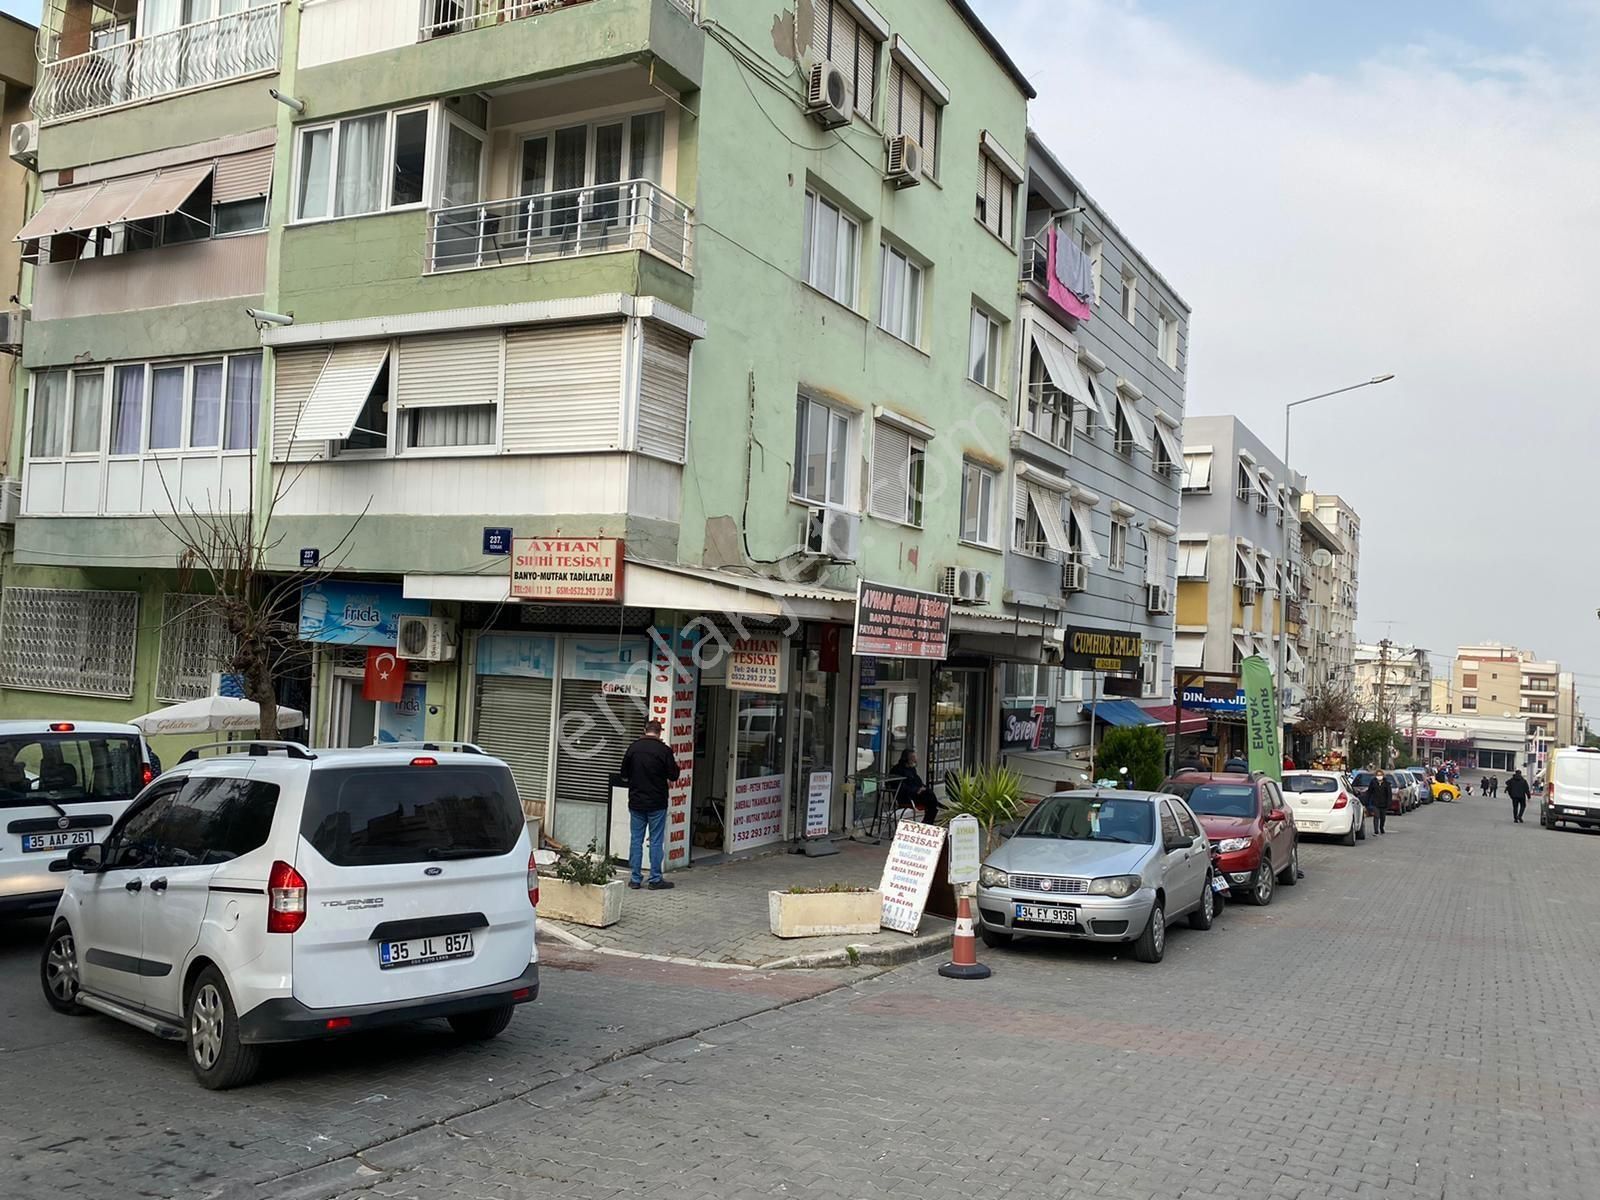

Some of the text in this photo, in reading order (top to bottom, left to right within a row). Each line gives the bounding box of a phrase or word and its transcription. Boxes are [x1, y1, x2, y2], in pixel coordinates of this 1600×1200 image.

[528, 541, 600, 553] AYHAN
[556, 554, 611, 568] TESİSAT
[514, 571, 613, 582] BANYO-MUTFAK TADİLATLARI
[862, 589, 894, 611] AYHAN
[919, 597, 949, 619] TESİSAT
[869, 613, 891, 624] BANYO
[892, 615, 916, 627] MUTFAK
[735, 639, 778, 653] AYHAN
[1073, 632, 1111, 655] CUMHUR
[734, 652, 777, 666] TESİSAT
[751, 828, 762, 839] 293
[903, 824, 940, 838] AYHAN
[30, 832, 90, 848] 35 AAP 261
[897, 833, 939, 849] TESİSAT
[321, 897, 384, 907] TOURNEO
[347, 903, 384, 911] COURIER
[1022, 908, 1074, 921] 34 FY 9136
[391, 934, 469, 961] 35 JL 857
